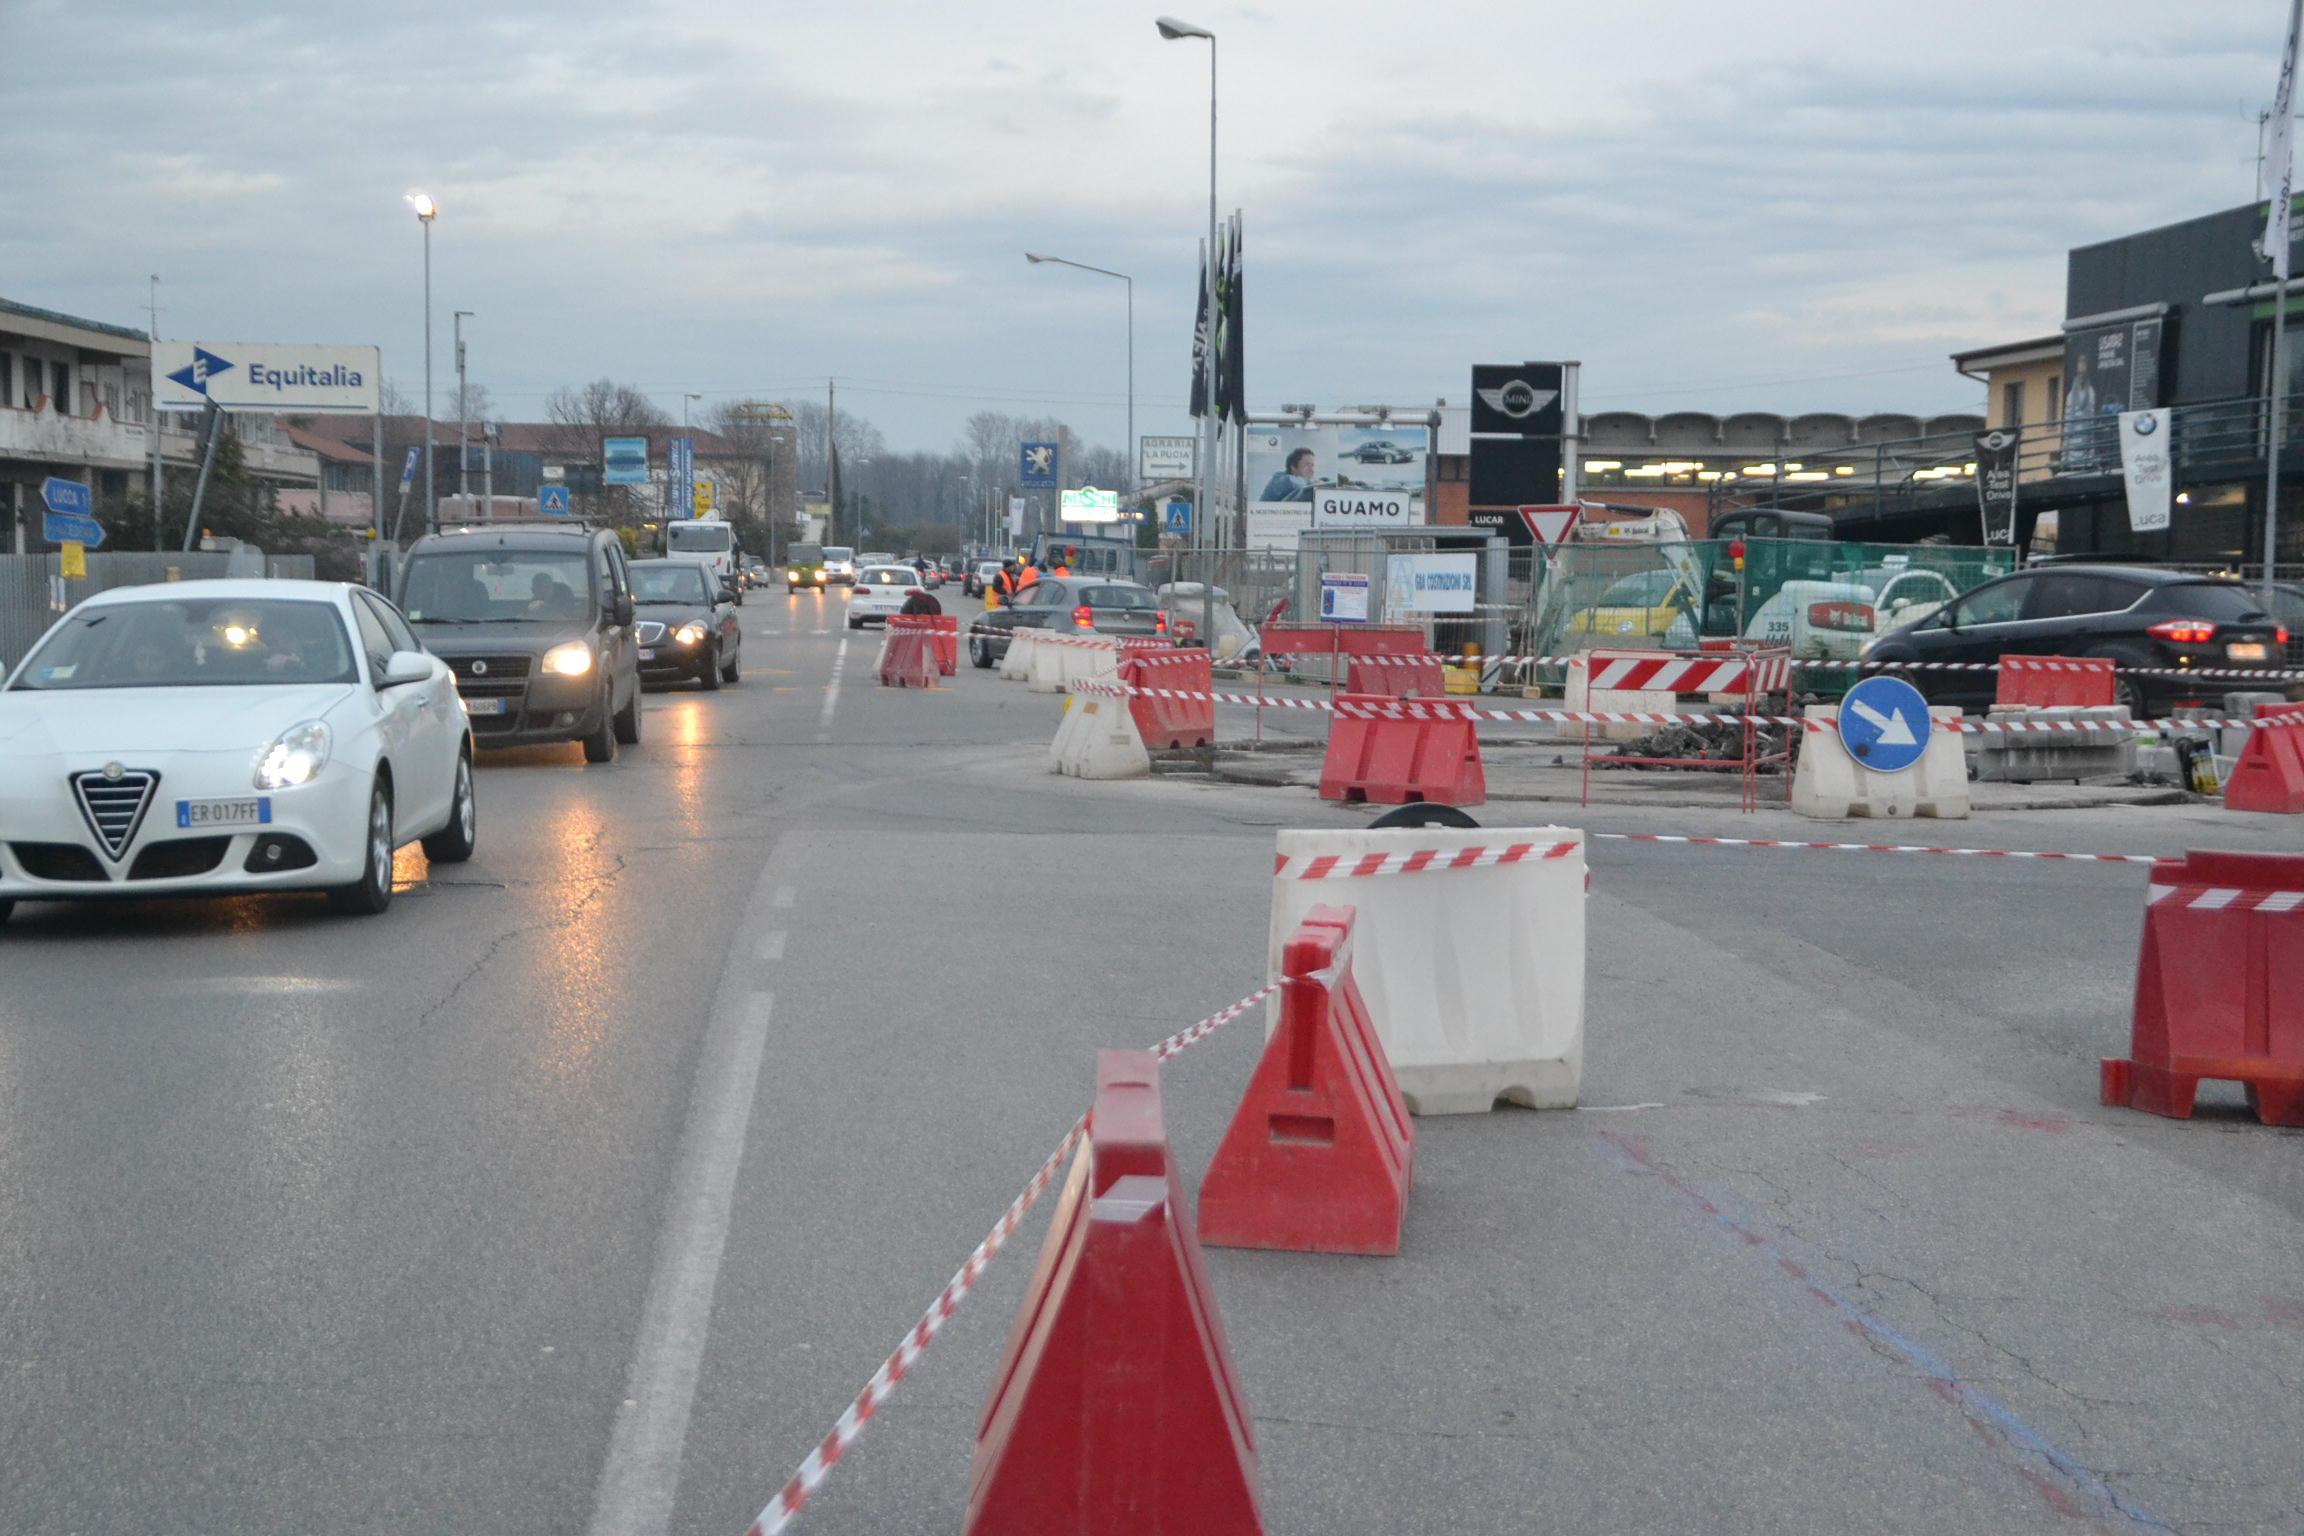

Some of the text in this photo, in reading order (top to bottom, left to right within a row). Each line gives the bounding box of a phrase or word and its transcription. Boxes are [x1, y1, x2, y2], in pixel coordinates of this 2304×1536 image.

[249, 363, 363, 391] Equitalia
[1505, 394, 1531, 405] MINI
[1143, 439, 1193, 448] AGRARIA
[2134, 453, 2160, 463] Area
[2137, 463, 2160, 473] Test
[1986, 469, 2010, 480] Area
[2134, 473, 2162, 485] Drive
[1988, 479, 2009, 490] Test
[1986, 490, 2012, 500] Drive
[1323, 499, 1400, 517] GUAMO
[1475, 515, 1504, 524] LUCAR
[1427, 573, 1461, 591] COSTRUZIONI
[1767, 622, 1789, 632] 335
[191, 802, 257, 822] ER 017FF
